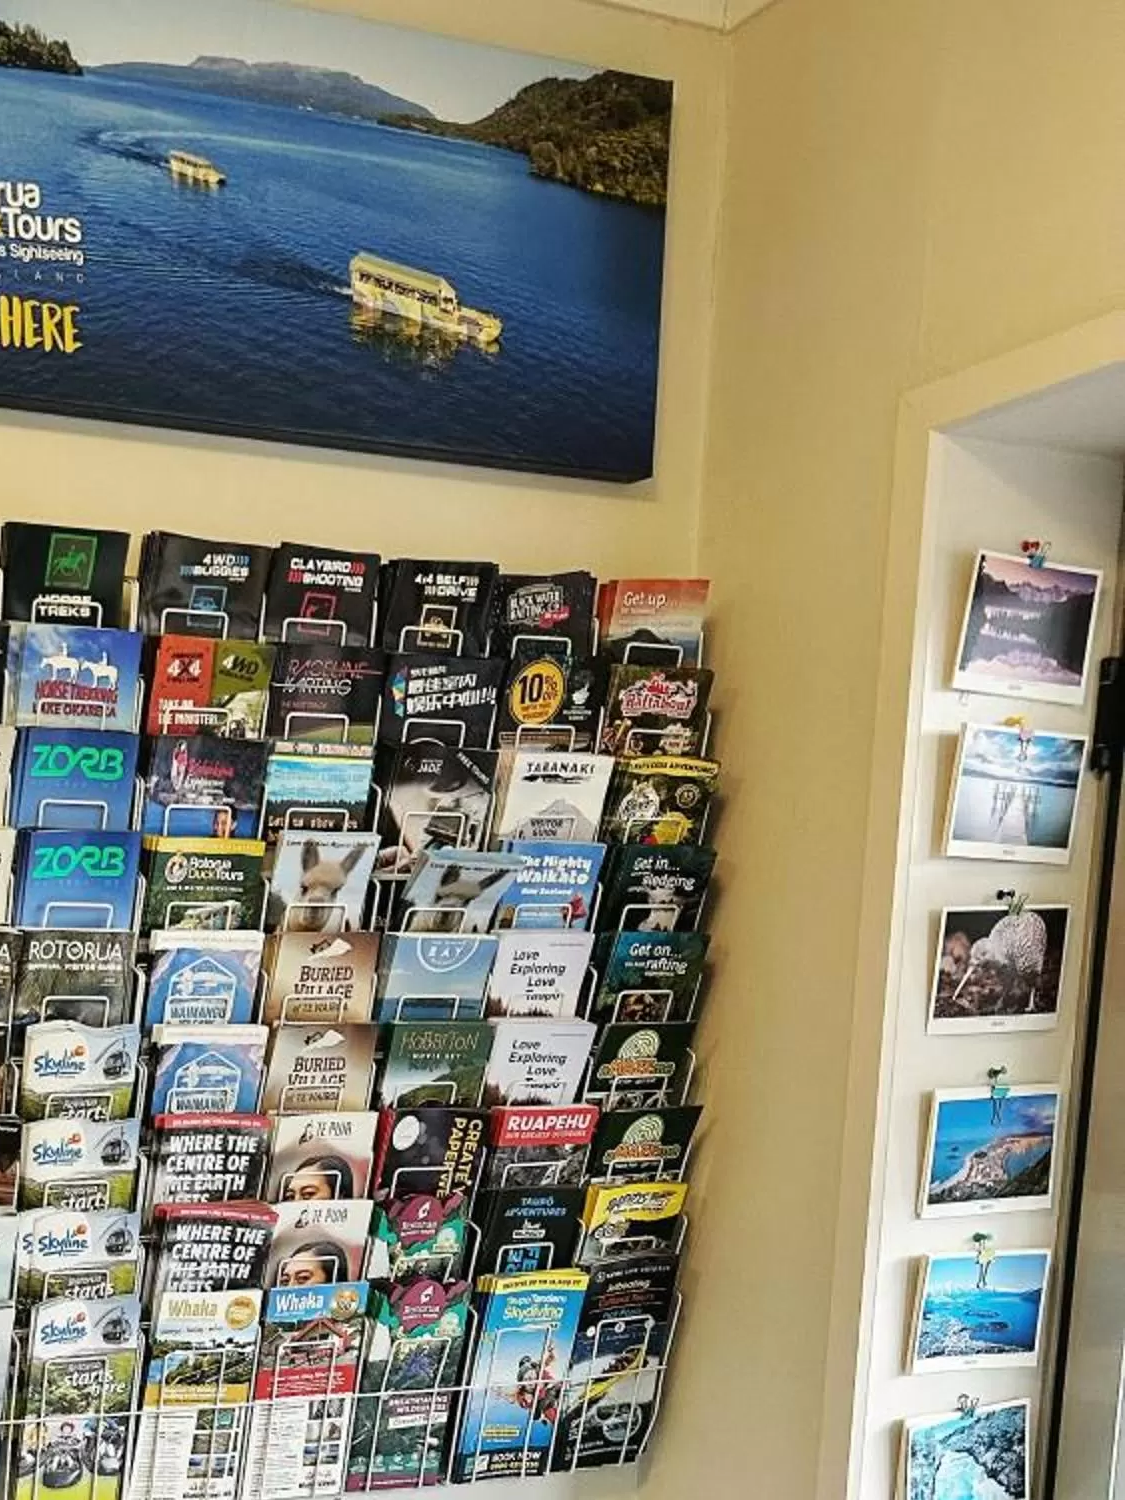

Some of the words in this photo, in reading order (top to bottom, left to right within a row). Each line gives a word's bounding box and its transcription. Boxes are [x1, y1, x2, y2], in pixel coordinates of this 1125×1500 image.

[290, 557, 352, 572] CLAYBIRD
[302, 573, 364, 587] SHOOTING
[623, 592, 646, 607] Get
[37, 605, 93, 618] TREKS
[31, 745, 124, 781] ZORB
[32, 845, 125, 879] ZORB
[189, 856, 232, 869] Rotorua
[542, 855, 593, 870] Mighty
[633, 857, 654, 872] Get
[516, 868, 590, 885] Waikato
[29, 940, 124, 961] ROTORUA
[513, 949, 540, 961] Love
[629, 944, 651, 958] Get
[299, 965, 354, 982] BURIED
[510, 962, 567, 976] Exploring
[644, 956, 689, 975] rafting
[526, 977, 556, 988] Love
[294, 983, 354, 1000] VILLAGE
[512, 1039, 541, 1050] Love
[33, 1048, 87, 1075] Skyline
[293, 1056, 347, 1073] BURIED
[508, 1051, 568, 1065] Exploring
[526, 1065, 557, 1077] Love
[288, 1073, 347, 1088] VILLAGE
[507, 1113, 592, 1131] RUAPEHU
[32, 1138, 86, 1164] Skyline
[169, 1134, 227, 1152] WHERE
[227, 1135, 259, 1152] THE
[454, 1119, 483, 1184] CREATE
[166, 1154, 226, 1173] CENTRE
[226, 1155, 250, 1172] OF
[504, 1207, 568, 1218] ADVENTURES
[38, 1230, 89, 1257] Skyline
[176, 1224, 234, 1243] WHERE
[233, 1226, 267, 1246] THE
[172, 1243, 233, 1262] CENTRE
[233, 1246, 257, 1262] OF
[168, 1298, 218, 1318] Whaka
[276, 1292, 324, 1313] Whaka
[40, 1319, 89, 1345] Skyline
